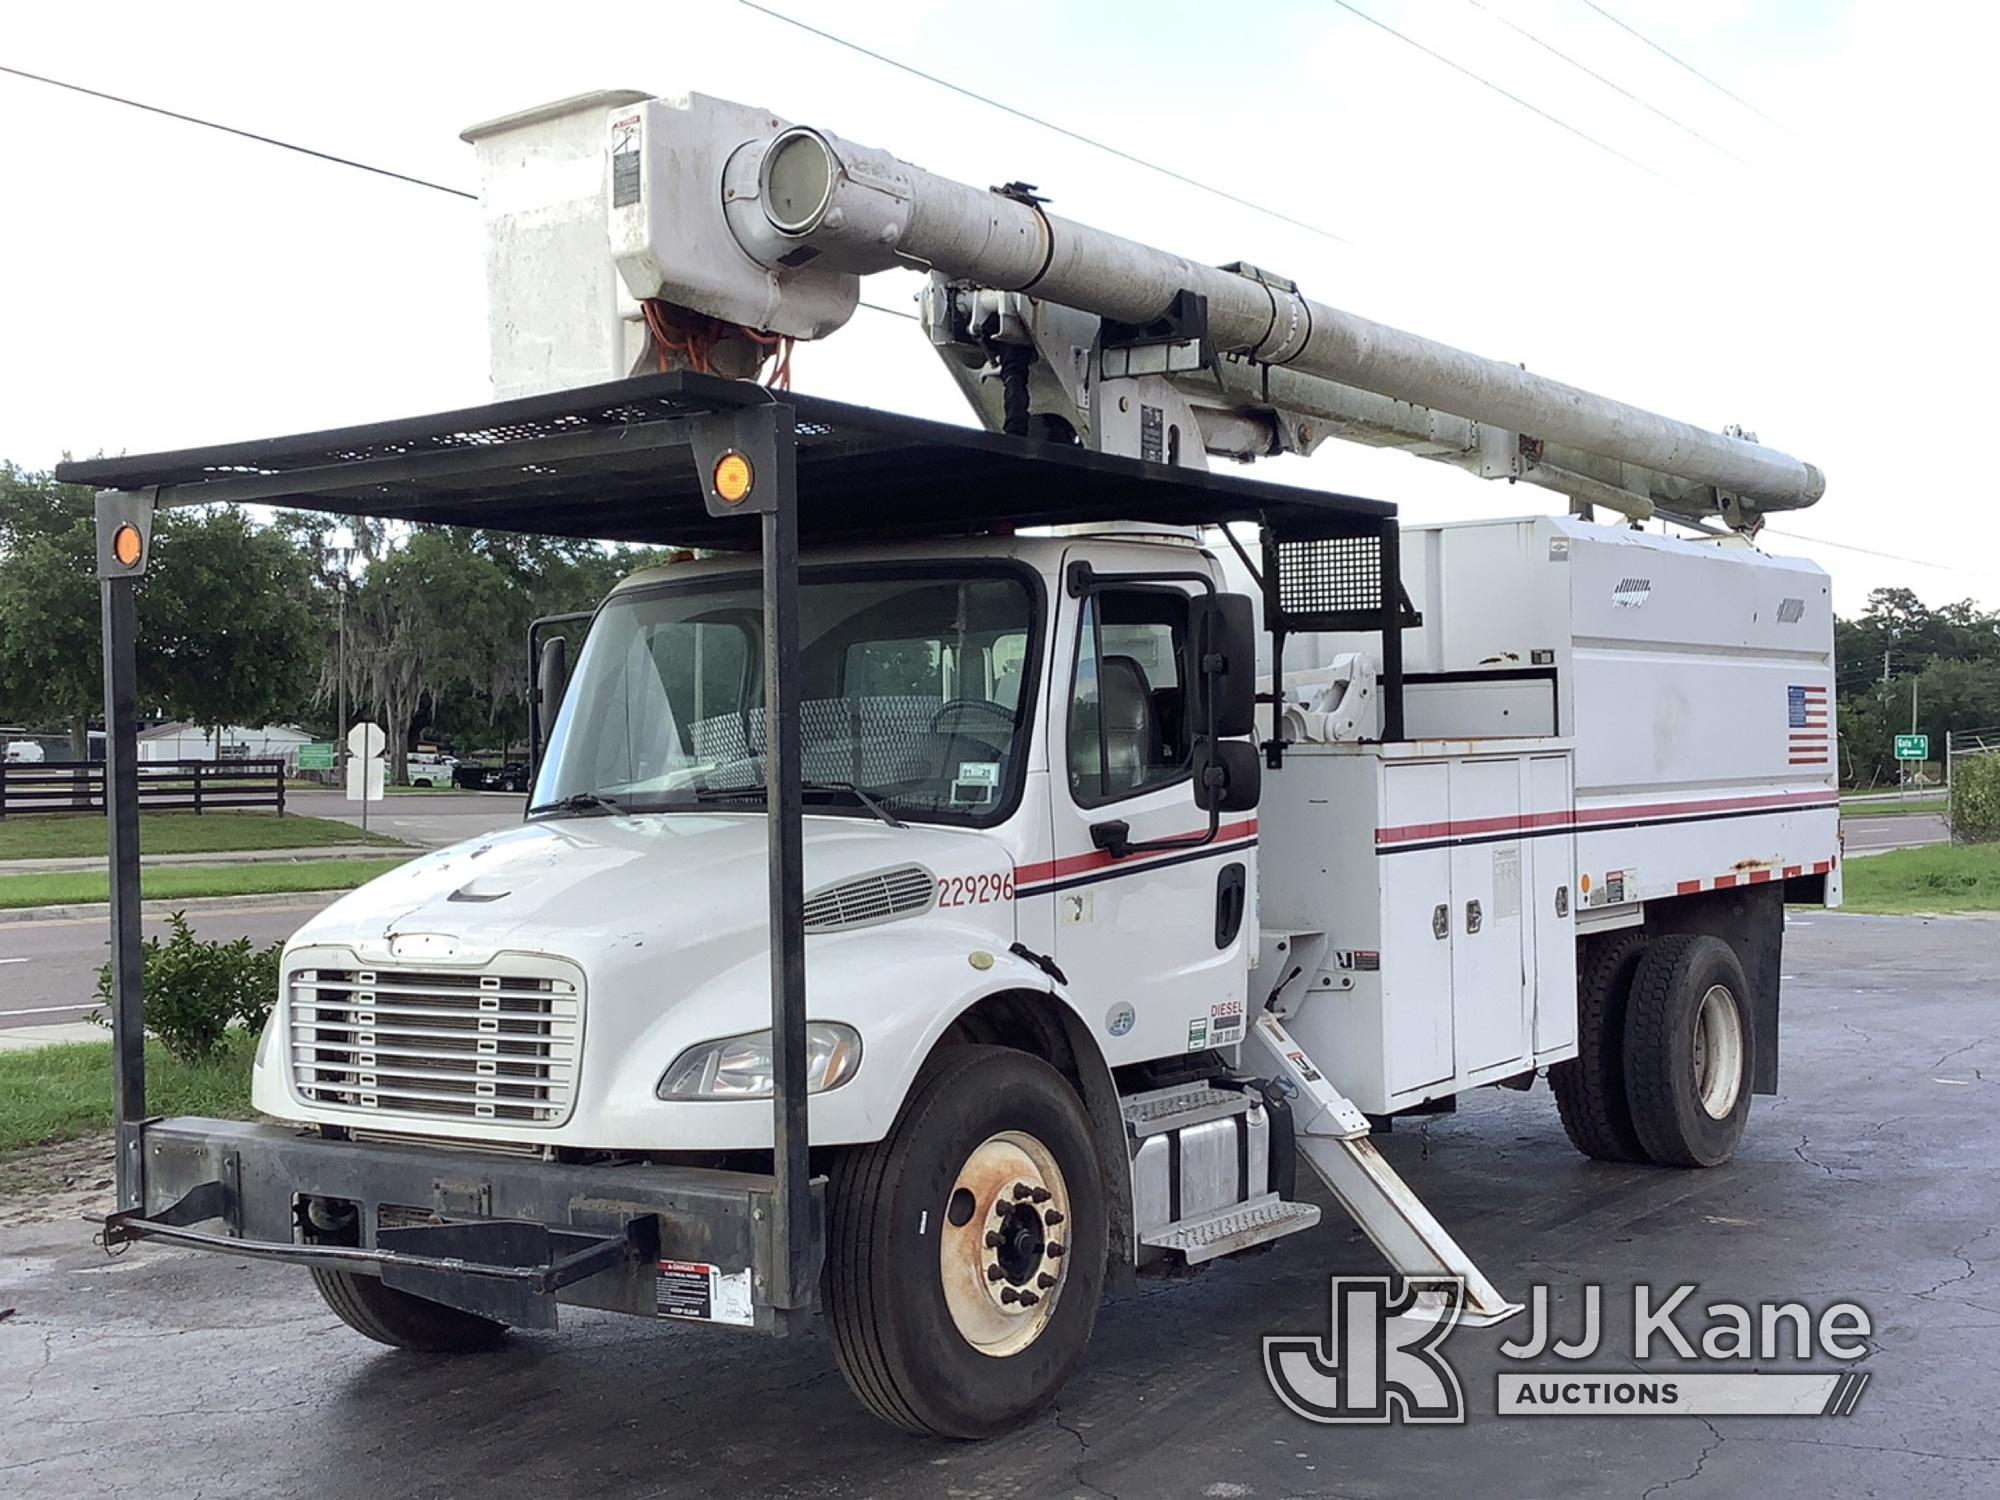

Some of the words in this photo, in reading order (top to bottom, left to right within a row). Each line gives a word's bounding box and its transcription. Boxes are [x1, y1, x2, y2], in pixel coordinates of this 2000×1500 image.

[938, 873, 1013, 908] 229296
[1211, 1001, 1243, 1017] DIESEL
[673, 1263, 695, 1272] DANGER
[683, 1308, 700, 1316] CLEAR
